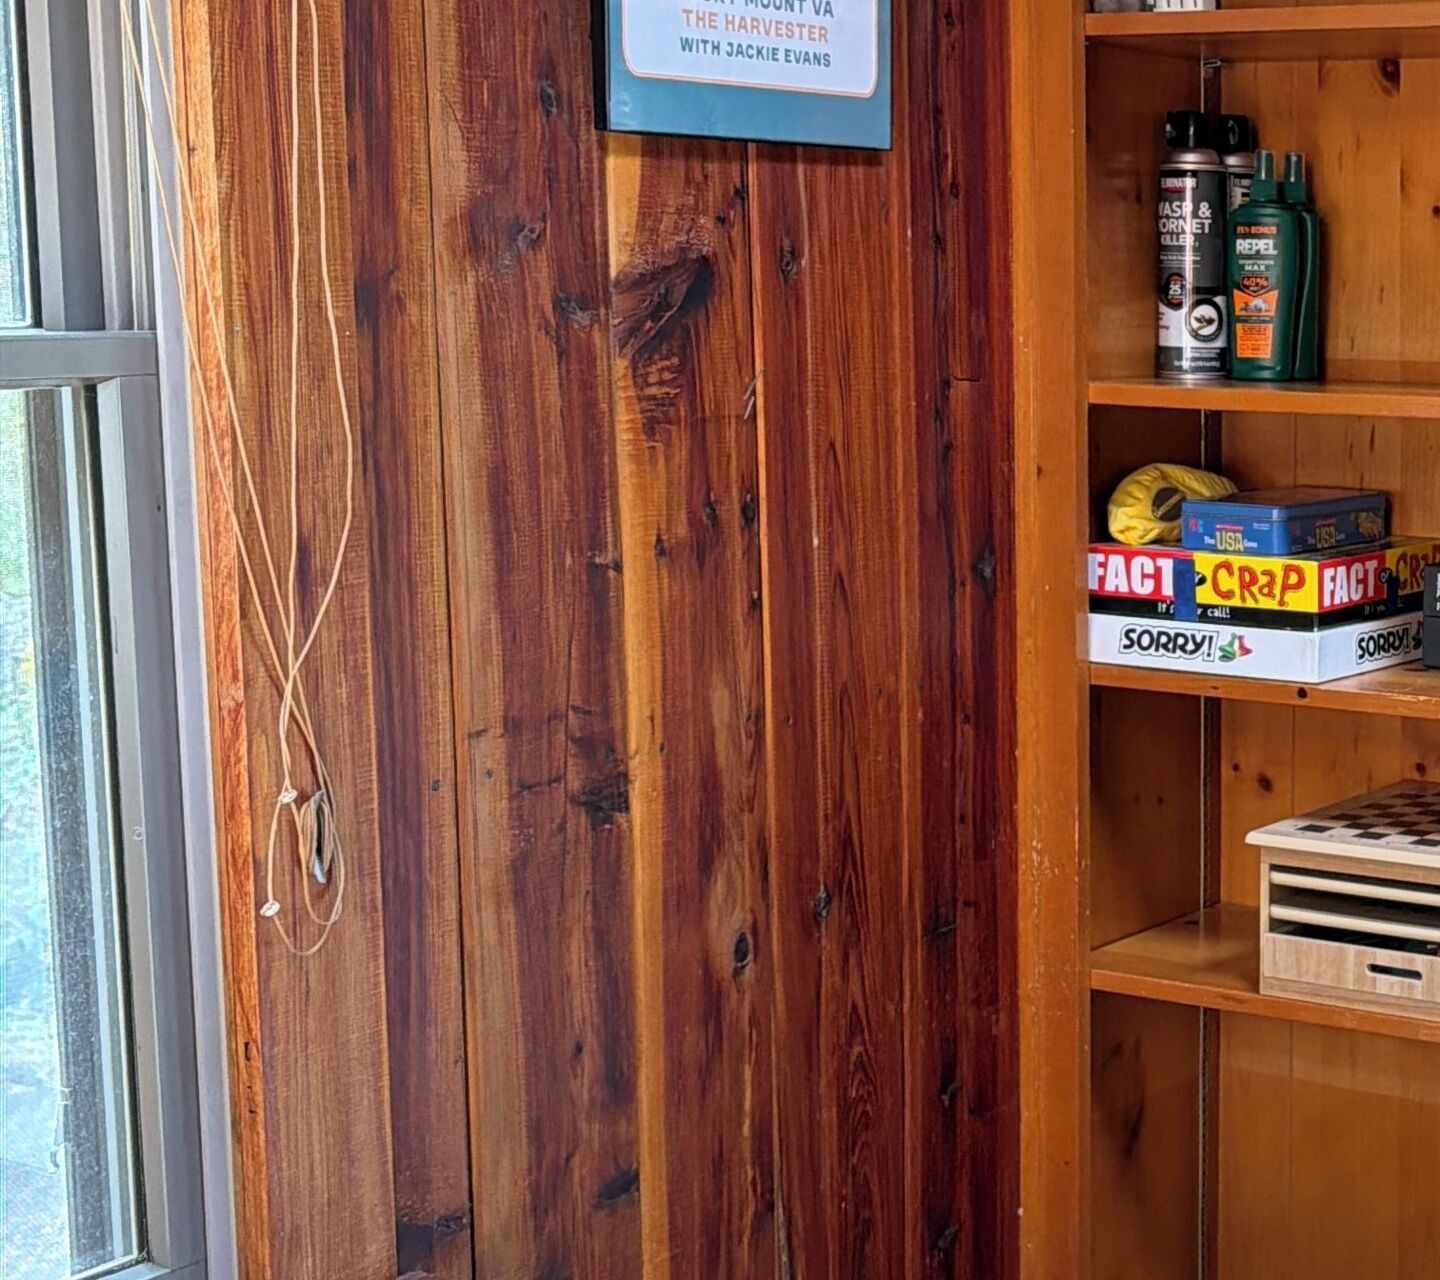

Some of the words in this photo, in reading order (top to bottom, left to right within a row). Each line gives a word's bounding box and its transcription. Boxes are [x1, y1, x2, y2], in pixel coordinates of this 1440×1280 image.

[682, 8, 718, 30] THE
[724, 13, 829, 43] HARVESTER
[679, 36, 721, 56] WITH
[725, 41, 780, 62] JACKIE
[784, 47, 832, 68] EVANS
[1198, 201, 1212, 218] &
[1158, 218, 1212, 234] ORNET
[1236, 238, 1278, 255] REPEL
[1243, 277, 1268, 286] 40%
[1215, 530, 1244, 552] USA
[1316, 526, 1336, 549] USA
[1088, 551, 1174, 597] FACT
[1322, 560, 1378, 608] FACT
[1207, 606, 1231, 619] call!
[1122, 628, 1215, 659] SORRY!
[1357, 627, 1410, 660] SORRY!
